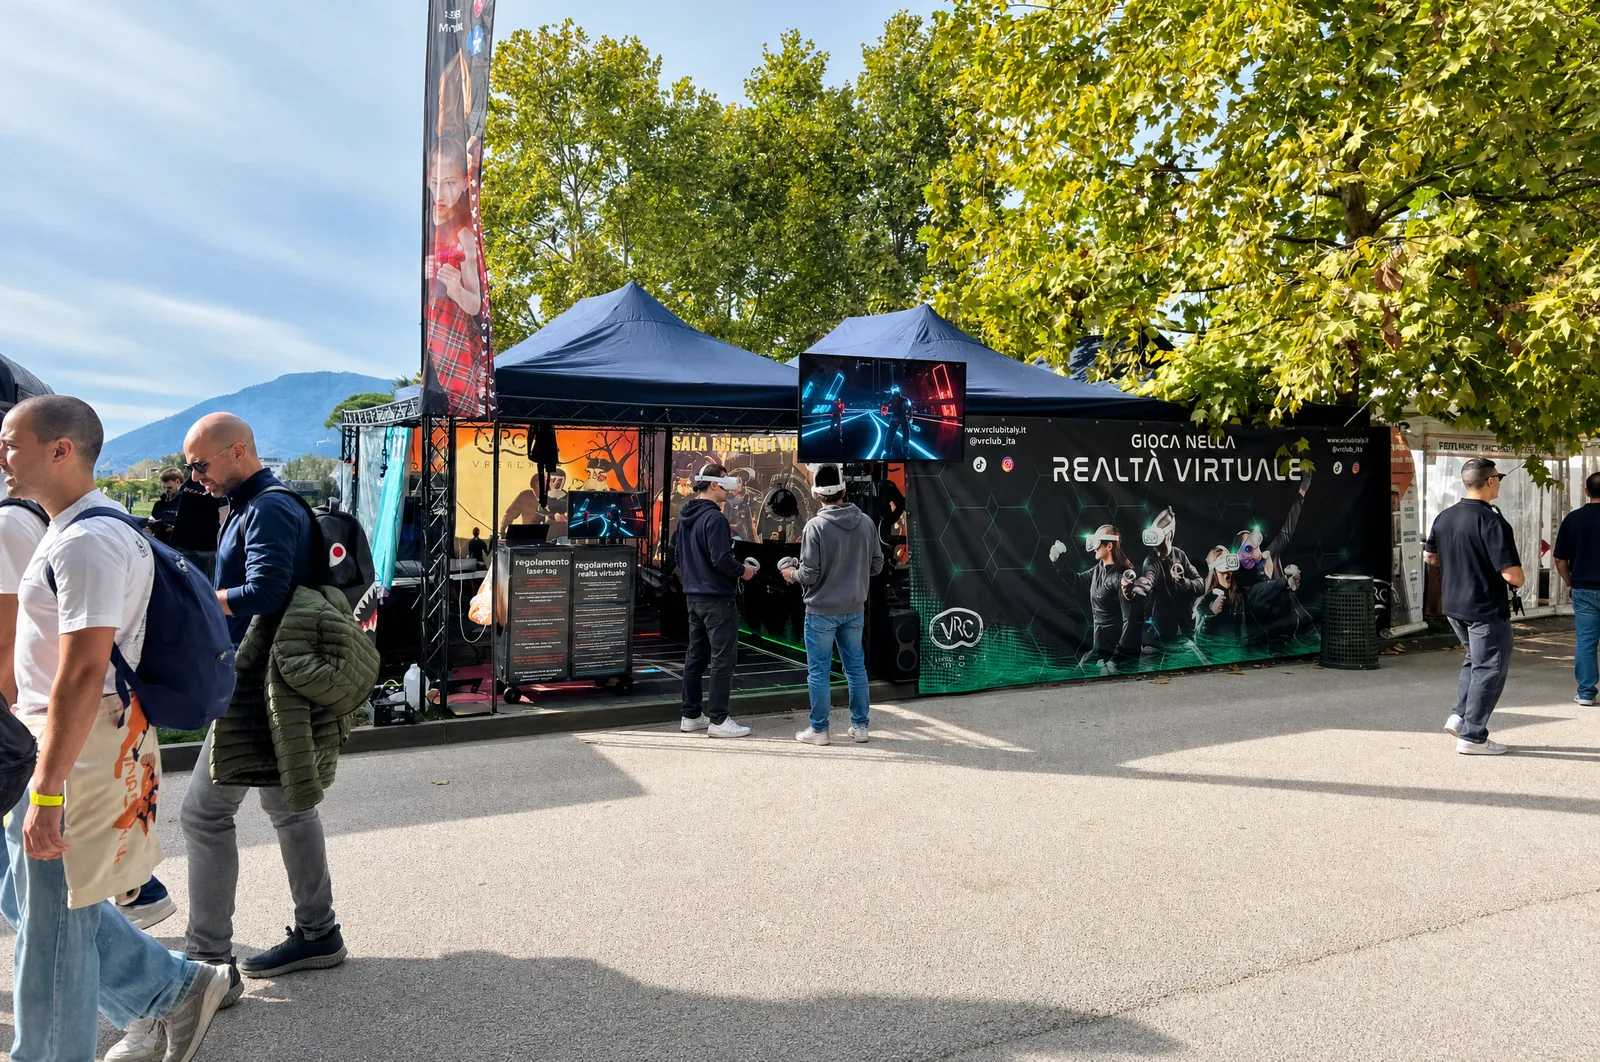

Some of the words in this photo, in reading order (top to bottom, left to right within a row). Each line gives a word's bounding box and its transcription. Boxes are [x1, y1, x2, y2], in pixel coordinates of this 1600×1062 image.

[671, 435, 708, 452] SALA
[969, 436, 1016, 447] @vrclub_ita
[1131, 433, 1181, 449] GIOCA
[1185, 434, 1236, 450] NELLA
[1052, 448, 1165, 482] REALTÀ
[1173, 458, 1302, 482] VIRTUALE
[515, 558, 570, 568] regolamento
[575, 560, 628, 571] regolamento
[526, 567, 545, 575] laser
[545, 567, 558, 576] tag
[599, 568, 626, 577] virtuale
[1373, 586, 1388, 603] RC
[940, 616, 974, 640] VRC
